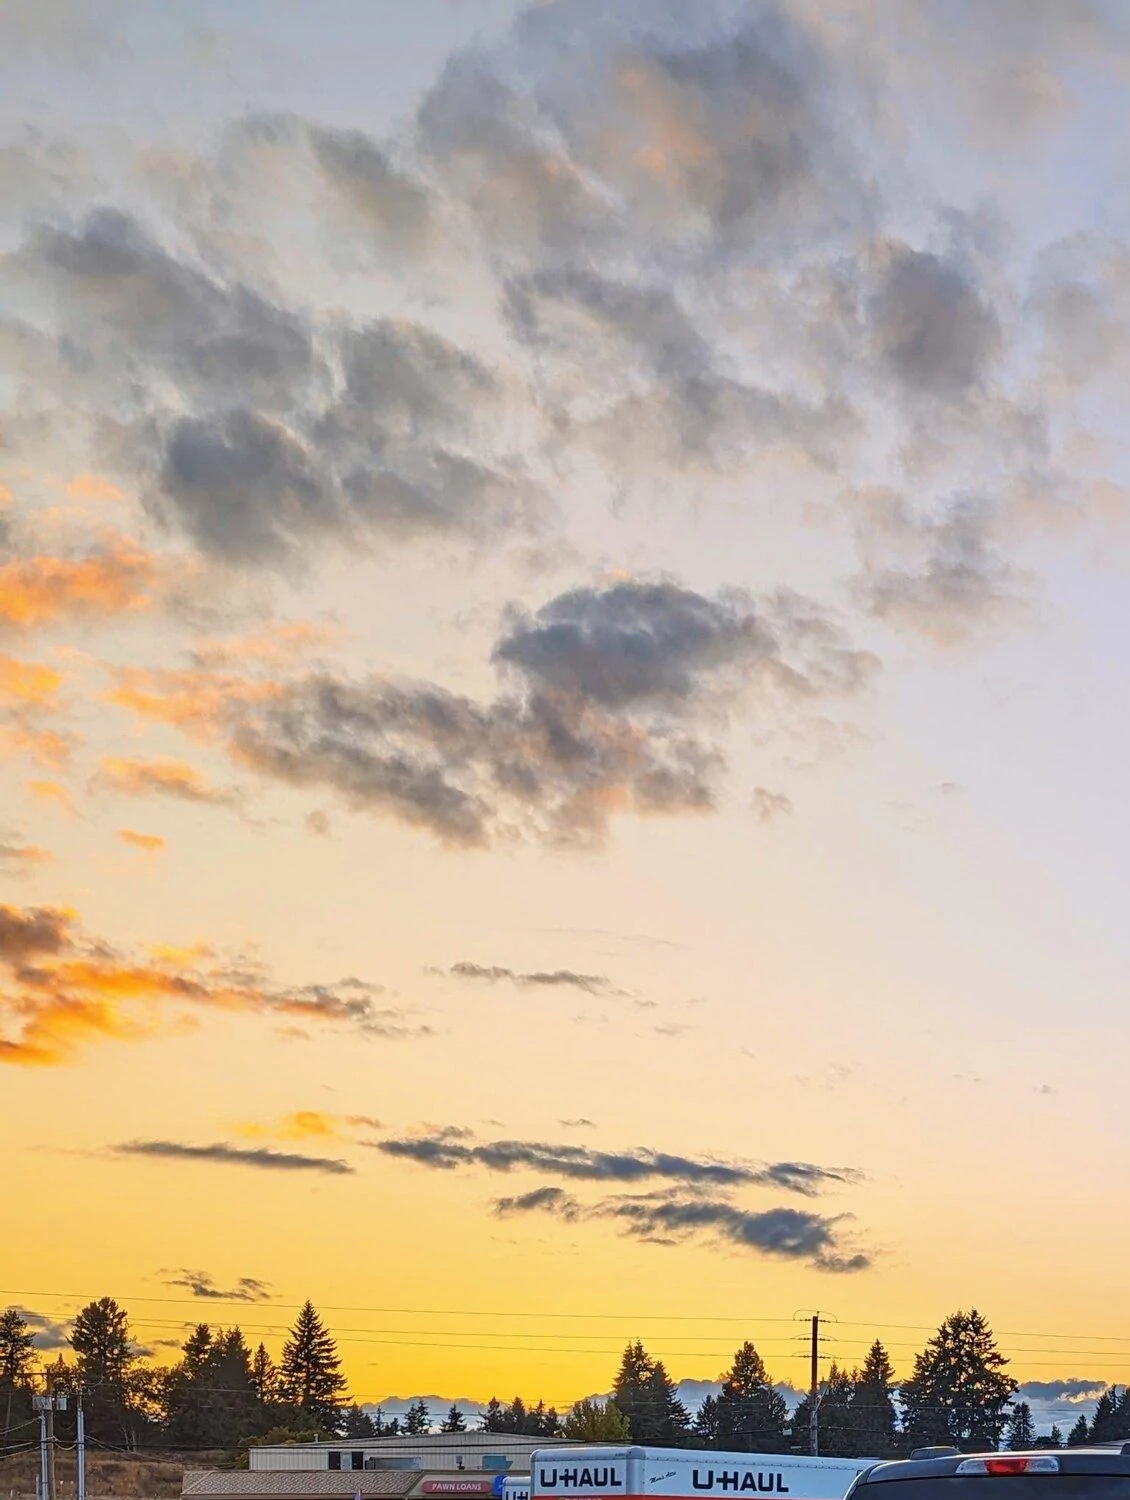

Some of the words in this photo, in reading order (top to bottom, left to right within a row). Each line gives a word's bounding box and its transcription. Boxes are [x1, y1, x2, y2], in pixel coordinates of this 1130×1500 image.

[432, 1482, 455, 1490] PAWN
[456, 1482, 481, 1490] LOANS
[540, 1467, 622, 1487] U-HAUL
[692, 1469, 789, 1492] U-HAUL
